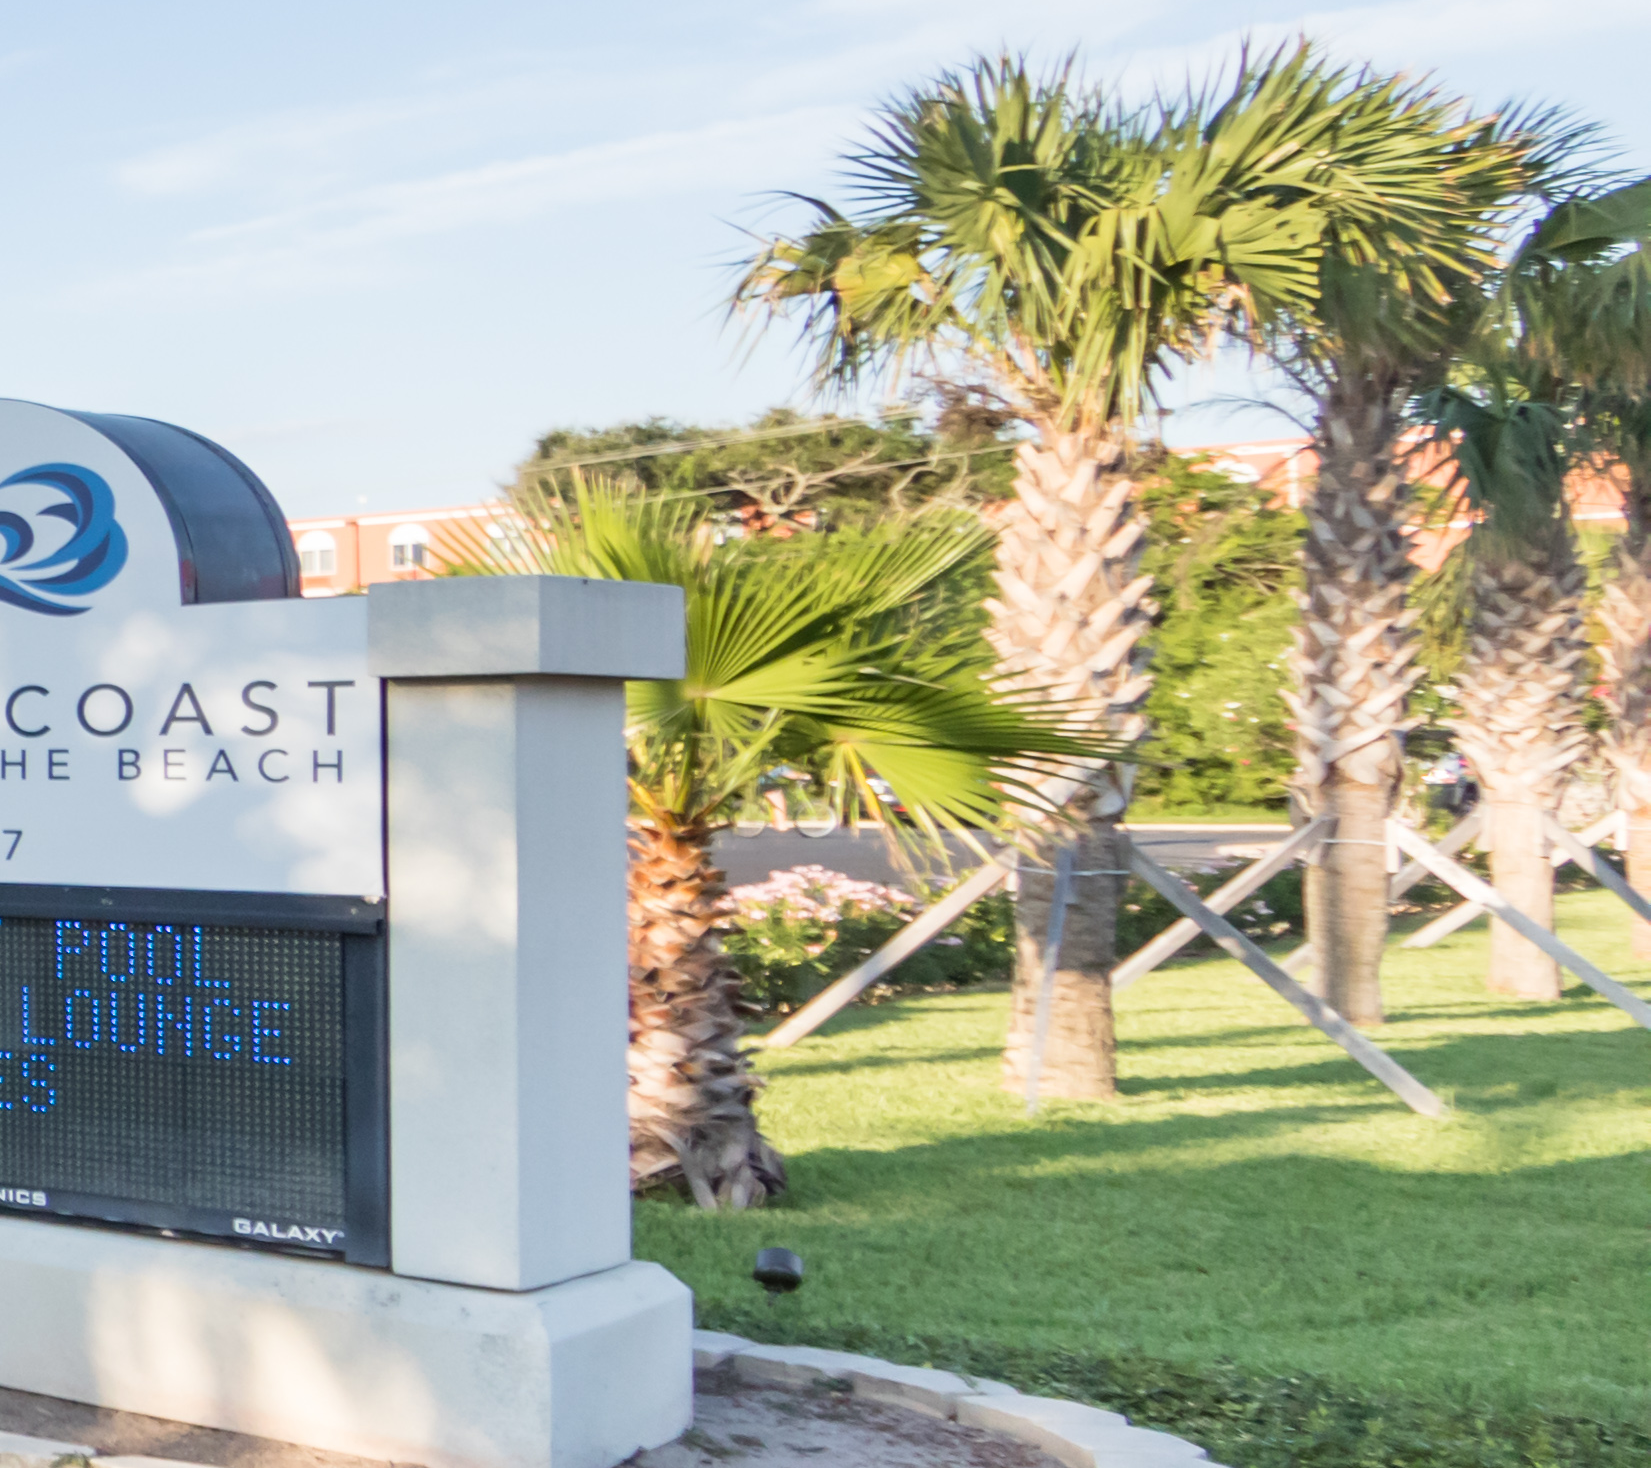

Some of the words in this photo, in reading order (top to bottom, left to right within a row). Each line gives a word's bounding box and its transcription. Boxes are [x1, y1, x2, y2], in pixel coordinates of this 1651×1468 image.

[5, 680, 356, 738] COAST
[117, 748, 343, 783] BEACH
[55, 920, 231, 988] POOL
[21, 985, 292, 1066] LOUNGE
